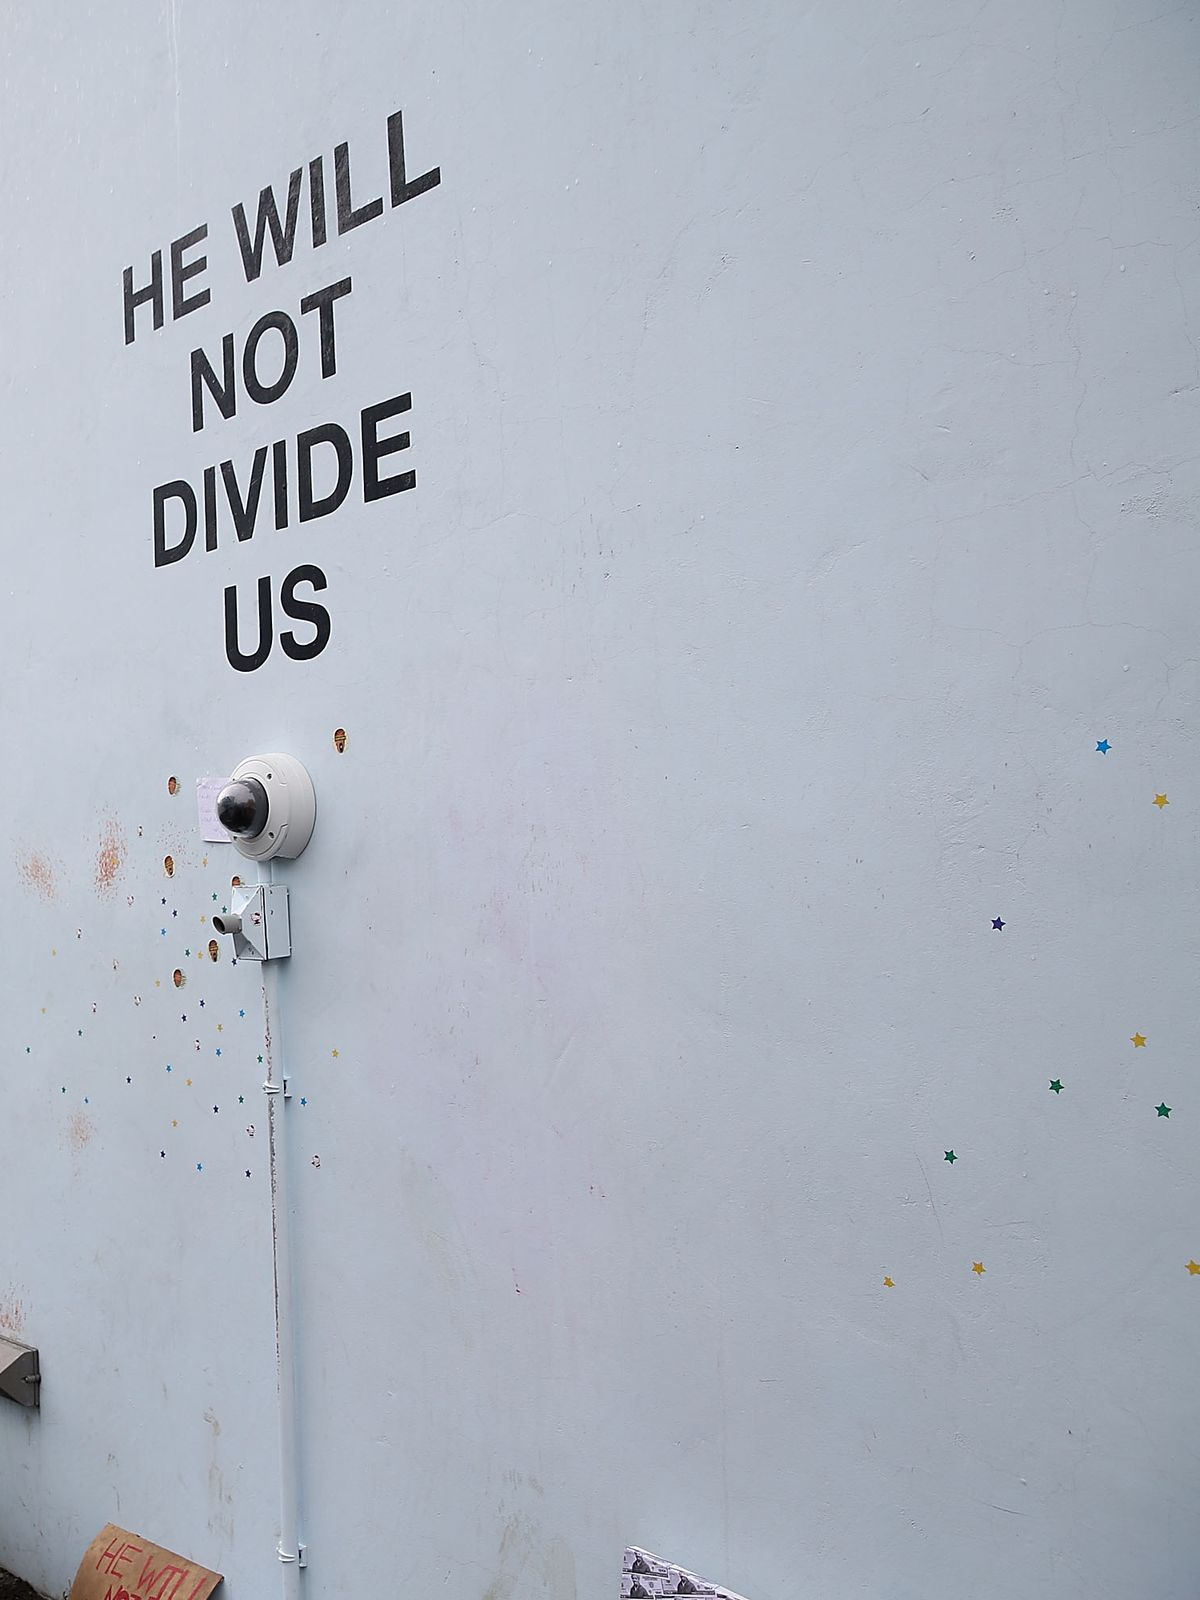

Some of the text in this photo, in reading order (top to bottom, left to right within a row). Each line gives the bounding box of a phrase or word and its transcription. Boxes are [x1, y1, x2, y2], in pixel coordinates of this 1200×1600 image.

[123, 110, 441, 345] HE WILL
[190, 277, 352, 433] NOT
[153, 392, 417, 568] DIVIDE
[224, 564, 331, 673] US
[96, 1538, 142, 1578] HE
